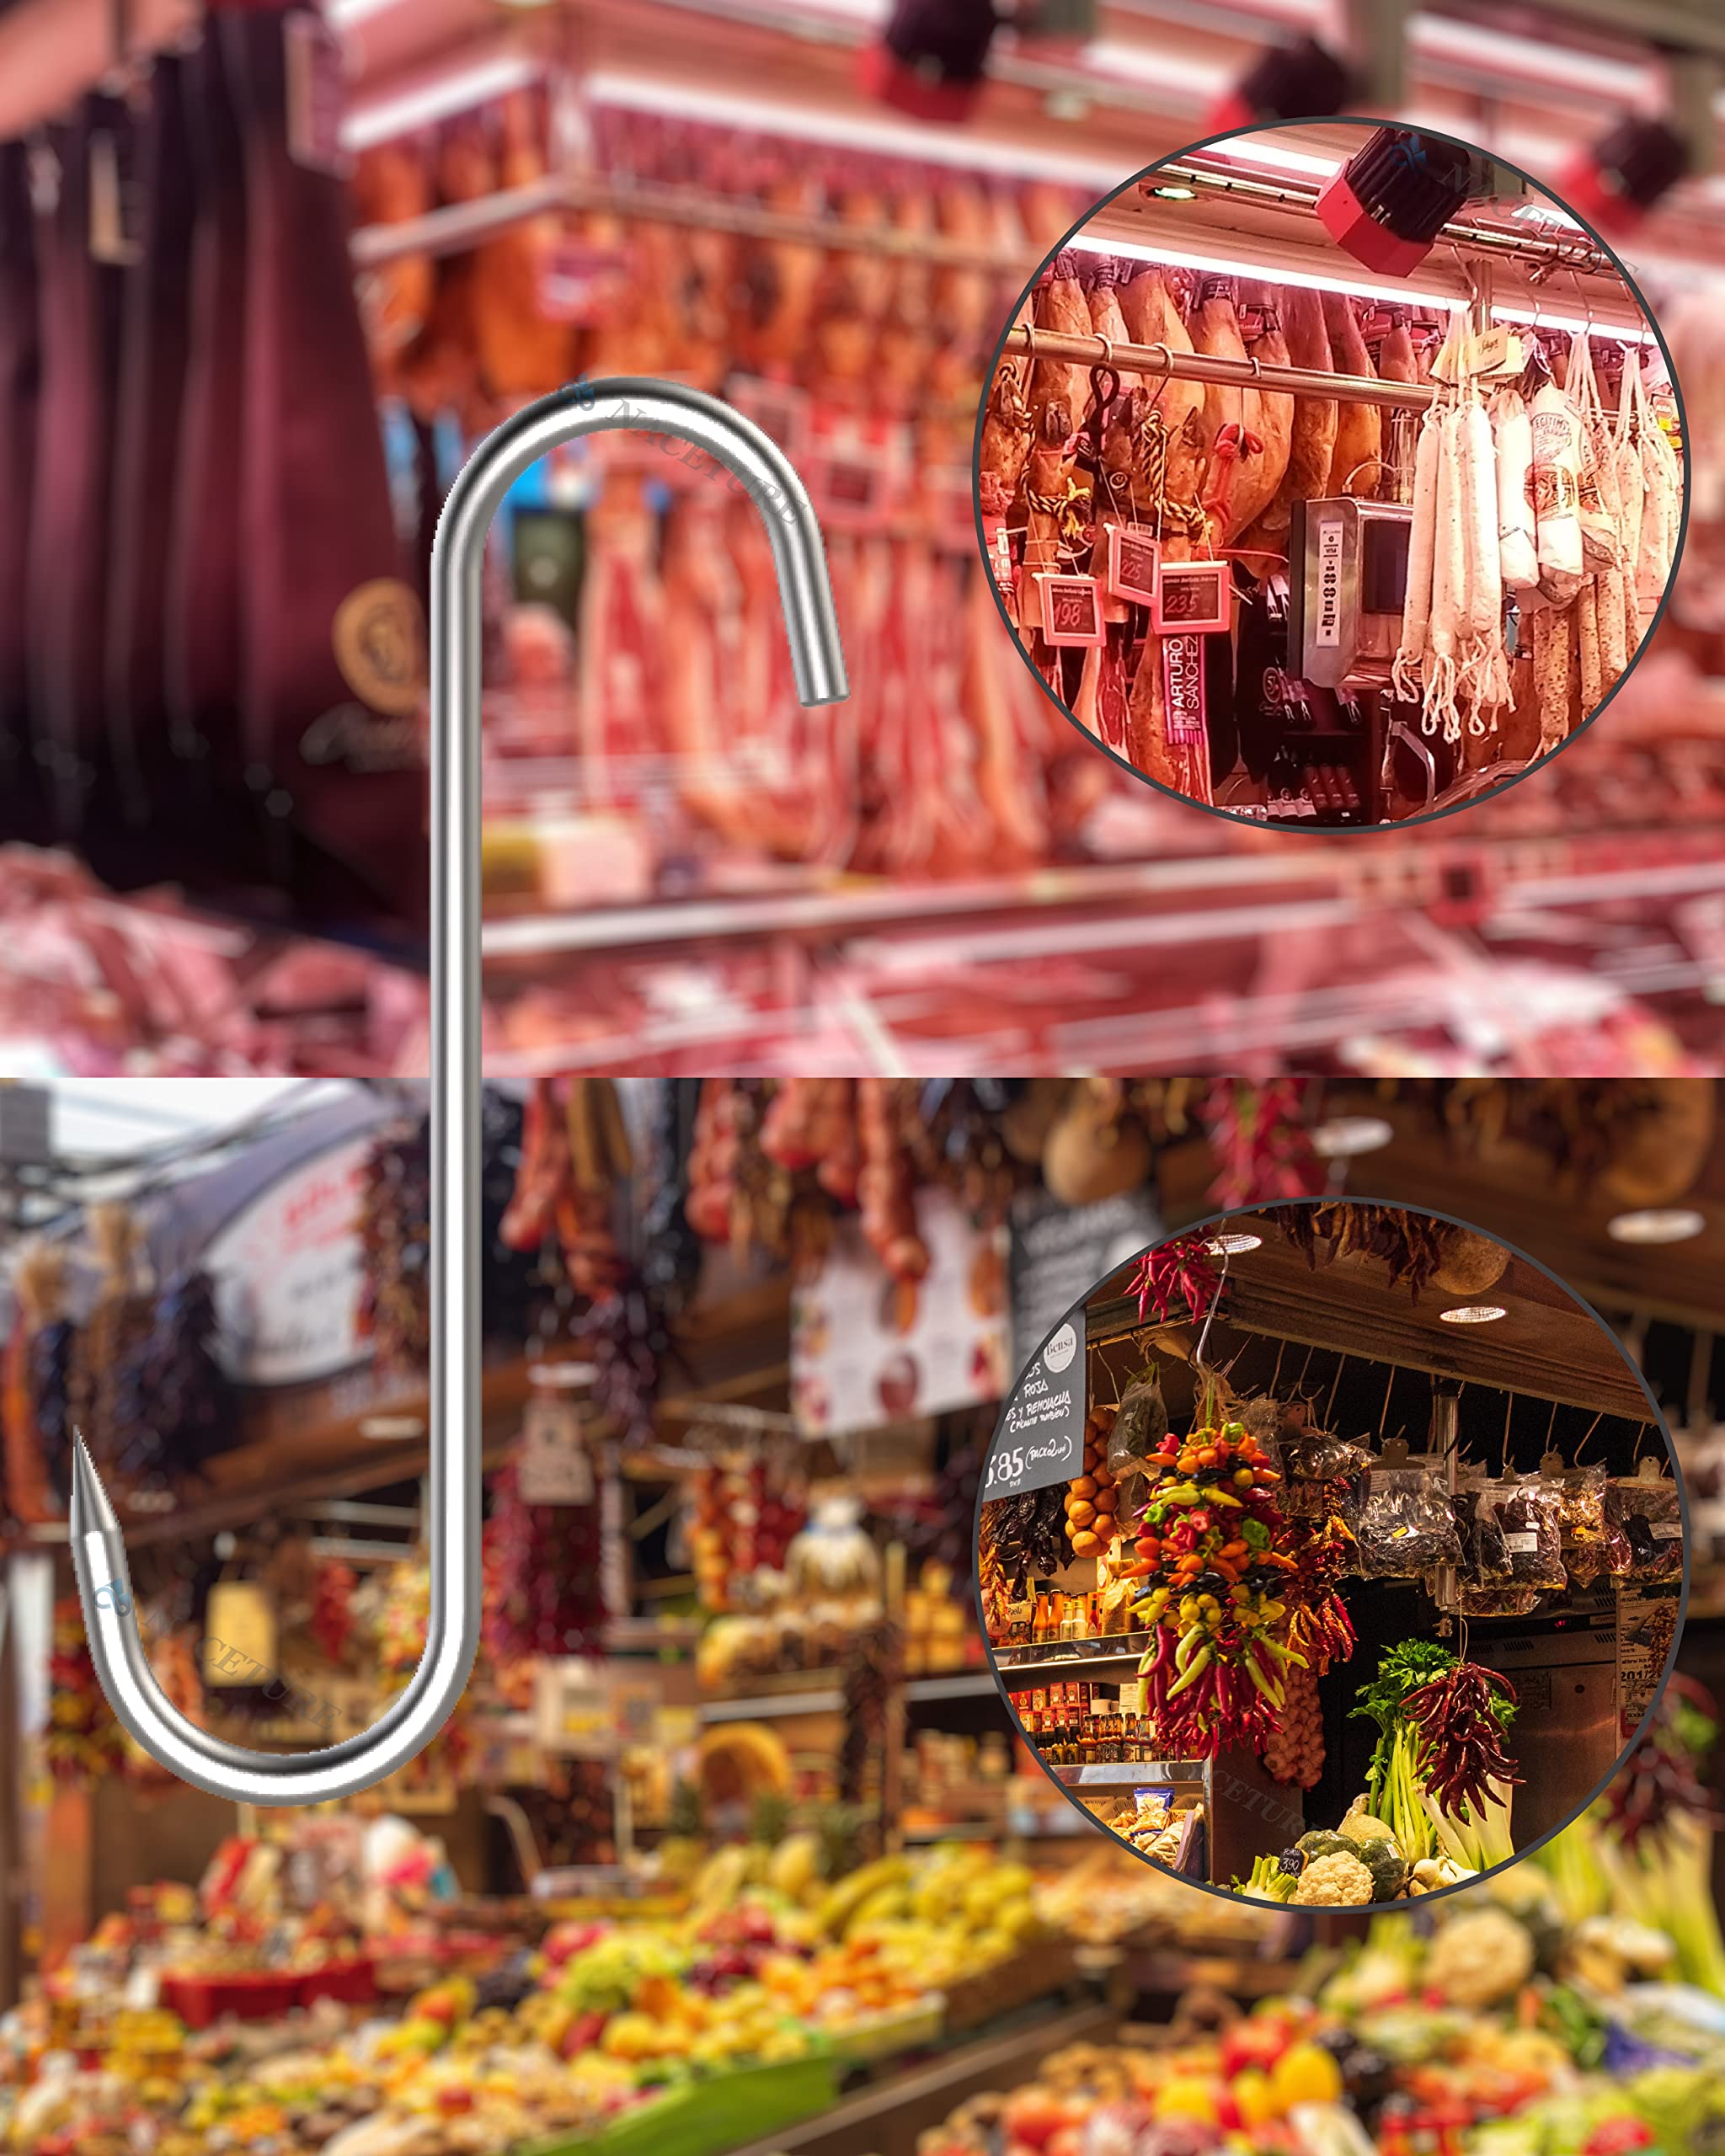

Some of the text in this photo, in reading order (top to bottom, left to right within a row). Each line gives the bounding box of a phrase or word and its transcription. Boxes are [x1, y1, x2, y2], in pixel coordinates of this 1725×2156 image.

[1121, 558, 1141, 581] 225
[1054, 602, 1081, 627] 198
[1164, 594, 1199, 614] 235
[1168, 639, 1184, 708] ARTURO
[1023, 1379, 1049, 1398] ROJA
